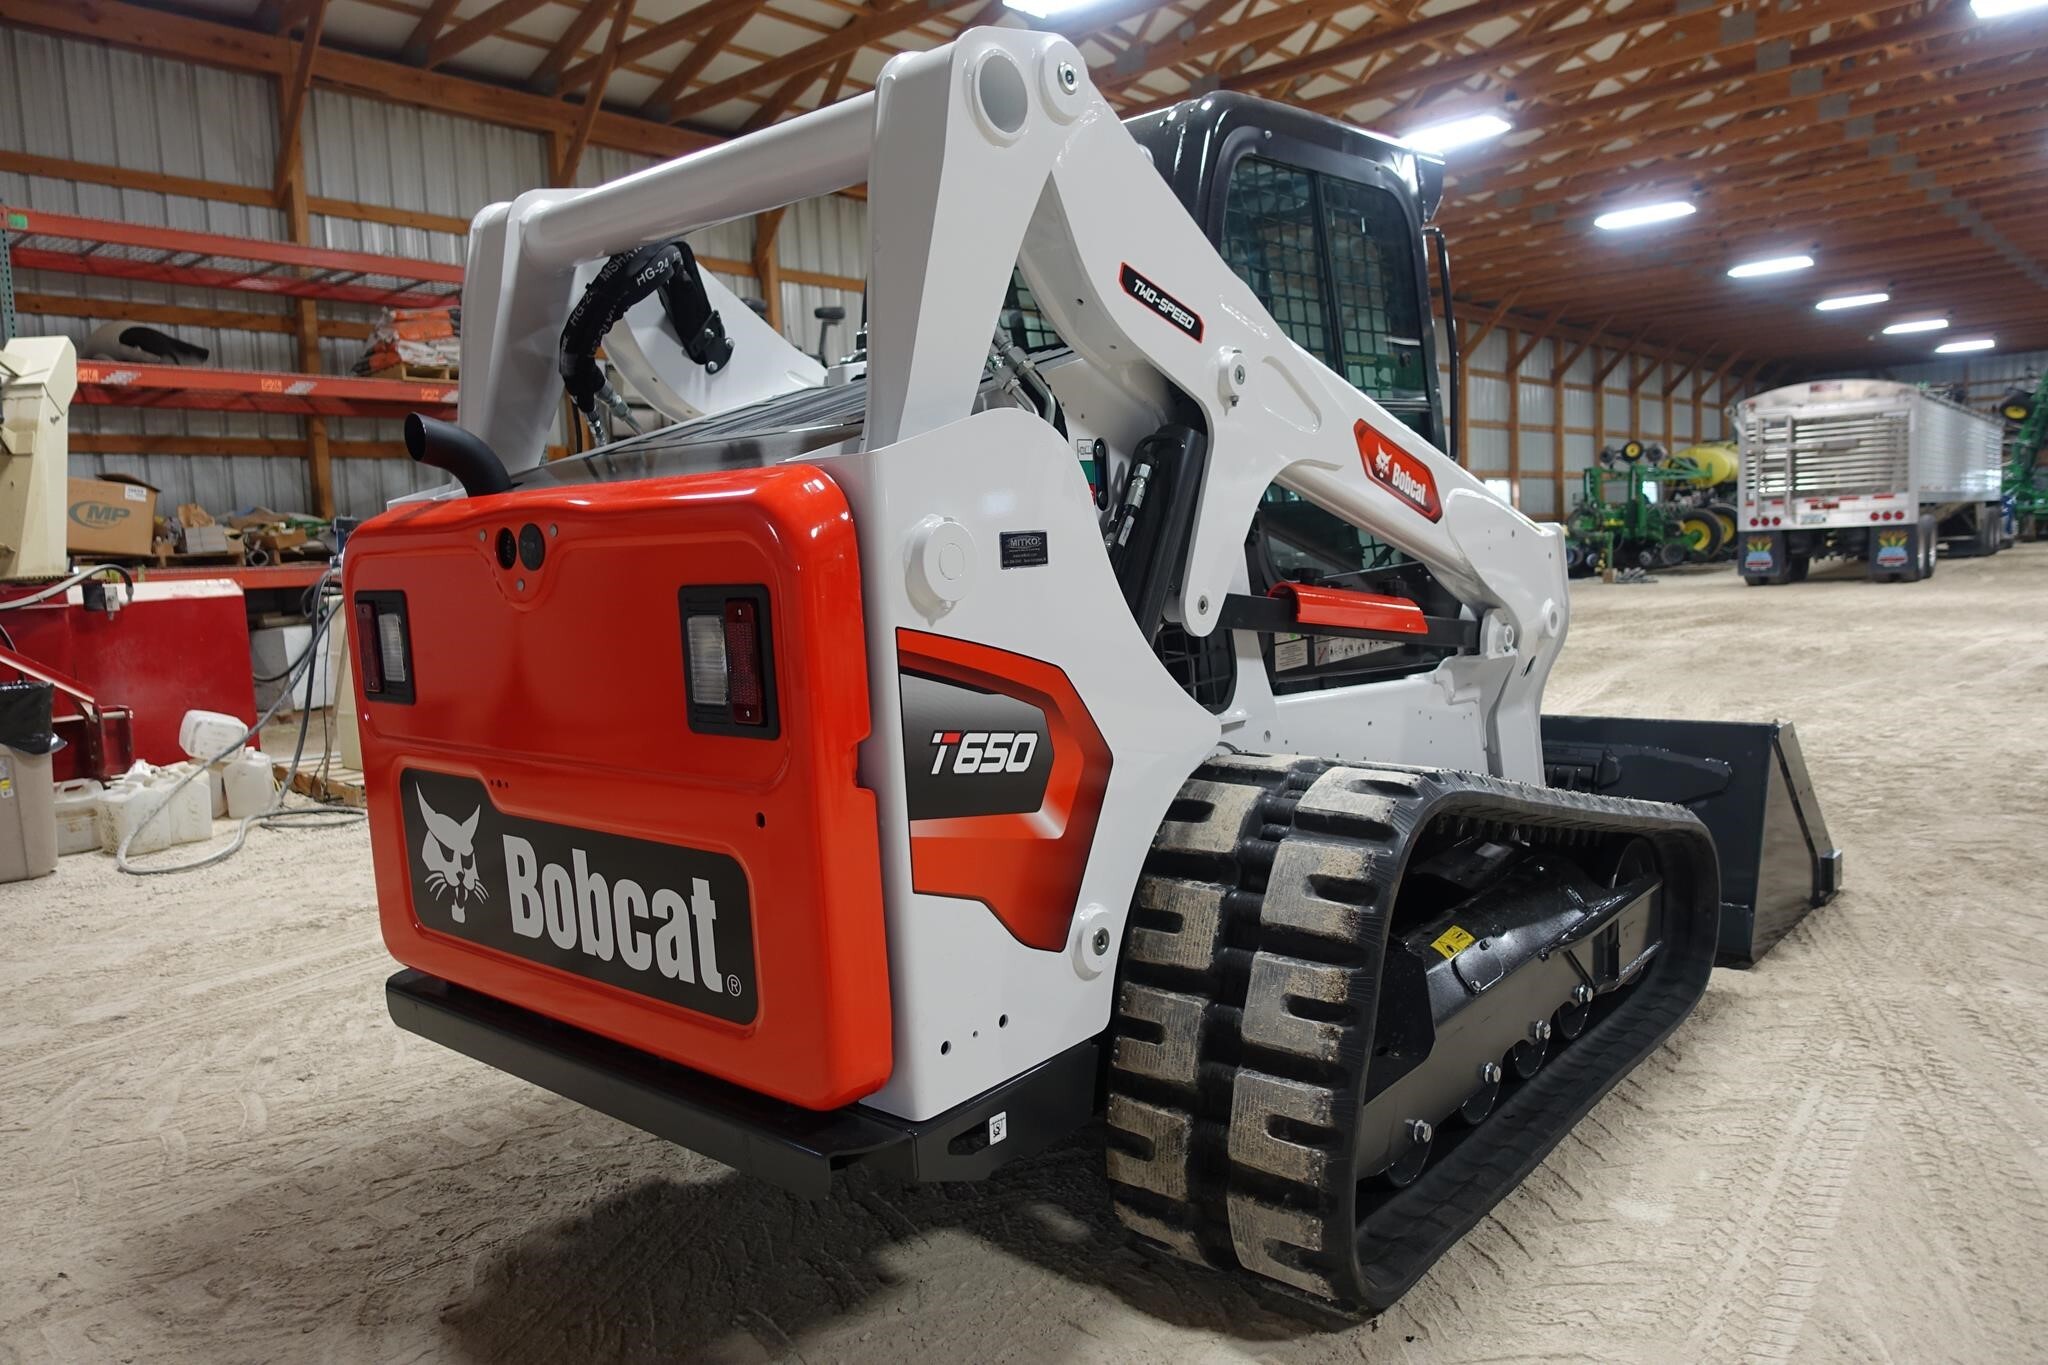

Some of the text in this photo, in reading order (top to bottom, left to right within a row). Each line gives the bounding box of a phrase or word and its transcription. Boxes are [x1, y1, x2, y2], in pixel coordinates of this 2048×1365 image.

[636, 258, 670, 287] HG-24
[1134, 279, 1195, 330] TWO-SPEED
[1392, 462, 1427, 506] Bobcat
[1010, 537, 1038, 547] MITKO
[931, 732, 1039, 774] T650
[503, 834, 724, 993] Bobcat
